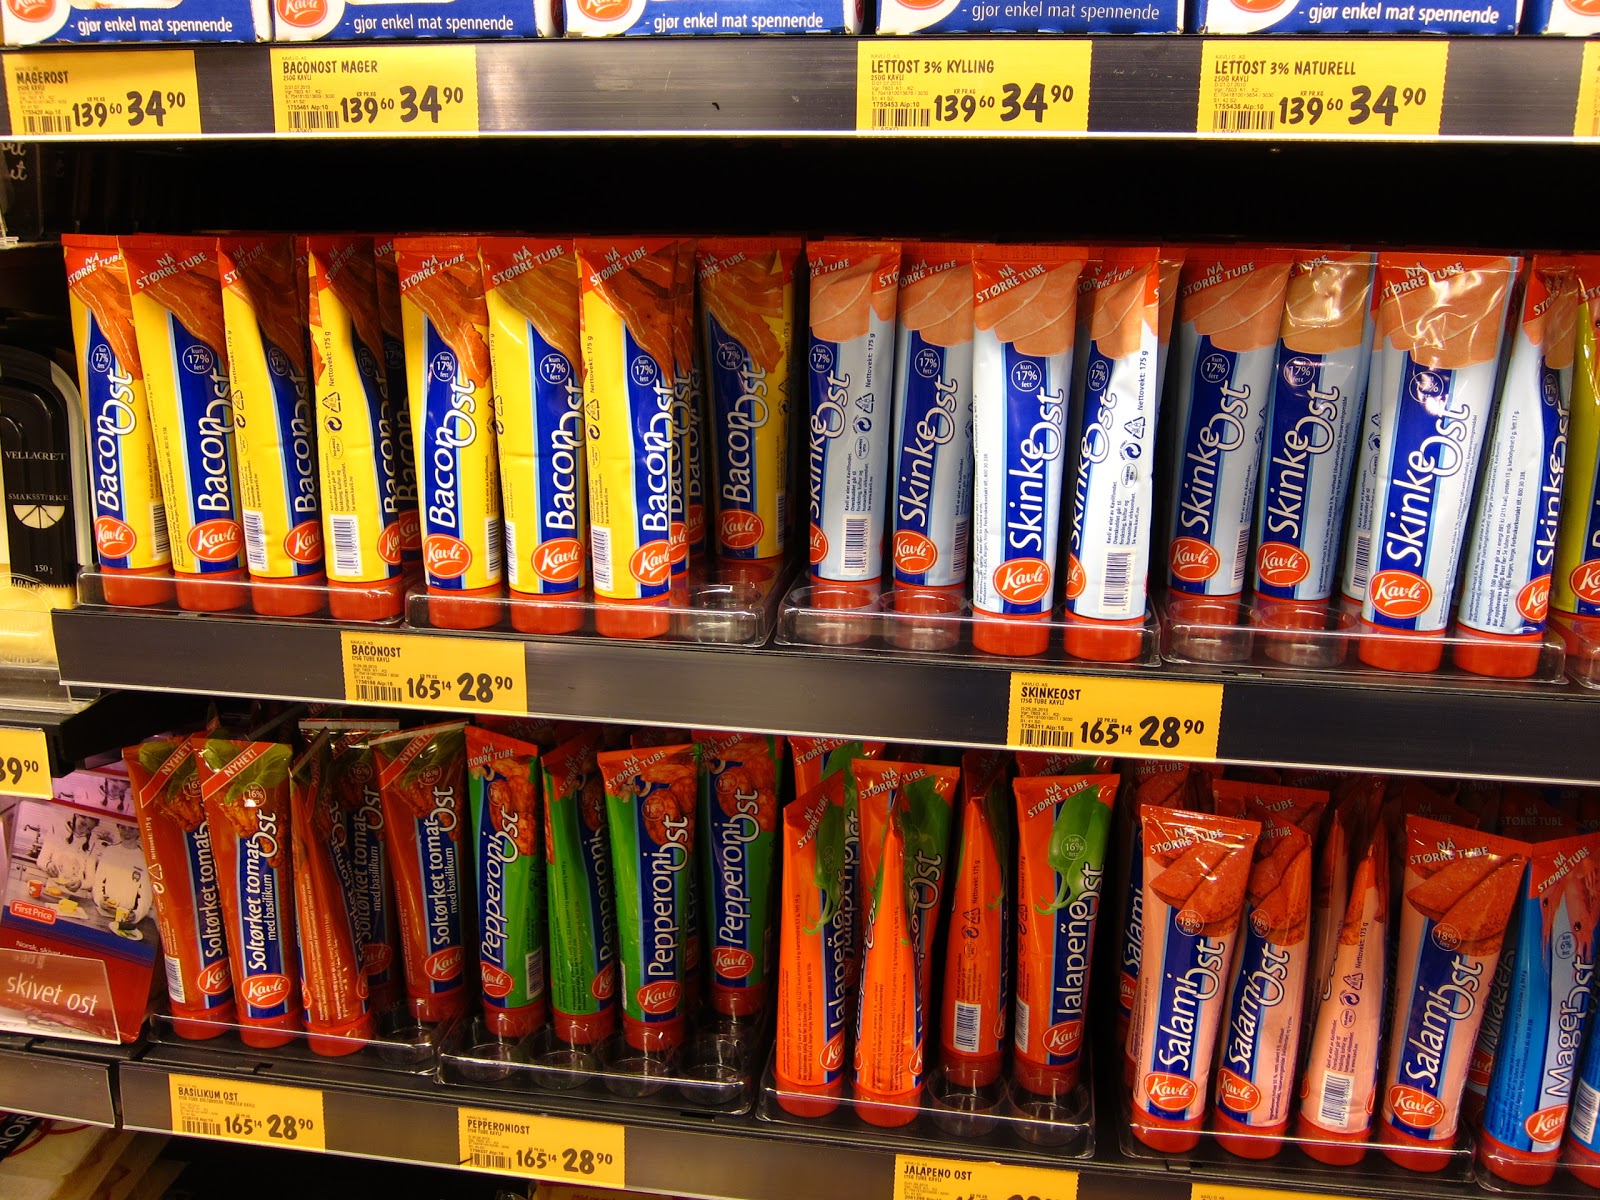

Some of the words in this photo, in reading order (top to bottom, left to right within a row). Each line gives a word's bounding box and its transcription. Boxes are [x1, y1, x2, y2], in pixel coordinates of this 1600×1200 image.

[653, 15, 679, 32] gjør
[683, 13, 717, 28] enkel
[722, 15, 747, 28] mat
[752, 12, 823, 32] spennende
[972, 4, 1000, 21] gjør
[1005, 1, 1042, 17] enkel
[1048, 4, 1075, 18] mat
[1080, 3, 1160, 22] spennende
[1309, 4, 1336, 23] gjør
[1341, 2, 1381, 19] enkel
[1385, 6, 1415, 20] mat
[1418, 6, 1499, 25] spennende
[77, 18, 101, 36] gjør
[105, 16, 137, 32] enkel
[140, 19, 164, 32] mat
[167, 16, 233, 35] spennende
[354, 17, 380, 34] gjør
[382, 14, 414, 29] enkel
[419, 16, 442, 29] mat
[446, 14, 513, 33] spennende
[16, 71, 69, 84] MAGEROST
[283, 61, 338, 74] BACONOST
[341, 60, 378, 73] MAGER
[872, 60, 920, 74] LETTOST
[924, 61, 942, 74] 3%
[947, 60, 994, 74] KYLLING
[1215, 61, 1266, 75] LETTOST
[1270, 62, 1289, 75] 3%
[1295, 61, 1356, 75] NATURELL
[127, 90, 166, 128] 34
[167, 92, 185, 109] 90
[340, 97, 378, 124] 139
[381, 98, 394, 110] 60
[400, 85, 442, 123] 34
[443, 87, 464, 104] 90
[934, 94, 976, 122] 139
[980, 96, 995, 108] 60
[1000, 83, 1048, 123] 34
[1051, 85, 1074, 103] 90
[1279, 96, 1323, 125] 139
[1327, 99, 1343, 110] 60
[1348, 85, 1399, 126] 34
[1403, 87, 1426, 106] 90
[72, 103, 107, 128] 139
[109, 104, 122, 114] 60
[157, 253, 175, 267] NÅ
[422, 254, 439, 269] NÅ
[492, 260, 535, 285] STØRRE
[534, 244, 564, 265] TUBE
[513, 246, 532, 262] NÅ
[136, 264, 179, 289] STØRRE
[180, 252, 208, 271] TUBE
[400, 267, 436, 291] STØRRE
[439, 253, 465, 270] TUBE
[998, 264, 1016, 278] NÅ
[976, 275, 1020, 303] STØRRE
[1019, 264, 1046, 281] TUBE
[436, 361, 453, 372] 17%
[545, 363, 565, 373] 17%
[635, 365, 653, 374] 17%
[1016, 370, 1037, 381] 17%
[1206, 362, 1225, 373] 17%
[5, 451, 67, 461] VELLACRET
[430, 376, 476, 528] BaconOst
[98, 523, 126, 543] Kavli
[198, 525, 237, 552] Kavli
[721, 517, 755, 541] Kavli
[427, 541, 462, 564] Kavli
[541, 543, 579, 571] Kavli
[896, 537, 927, 559] Kavli
[1173, 544, 1212, 565] Kavli
[639, 548, 670, 575] Kavli
[1261, 550, 1301, 571] Kavli
[1002, 567, 1044, 590] Kavli
[1374, 579, 1420, 602] Kavli
[351, 645, 401, 658] BACONOST
[407, 677, 441, 700] 165
[442, 681, 452, 691] 14
[457, 672, 494, 703] 28
[495, 676, 513, 691] 90
[1021, 687, 1081, 701] SKINKEOST
[1080, 721, 1119, 744] 165
[1121, 725, 1132, 735] 14
[1140, 716, 1181, 748] 28
[1184, 719, 1205, 735] 90
[24, 760, 38, 772] 90
[224, 749, 257, 777] NYHET!
[606, 765, 640, 789] STØRRE
[640, 750, 666, 768] TUBE
[623, 754, 639, 768] NÅ
[1028, 794, 1062, 818] STØRRE
[1063, 779, 1089, 797] TUBE
[1045, 782, 1061, 795] NÅ
[716, 953, 747, 970] Kavli
[7, 973, 63, 1006] skivet
[67, 989, 98, 1017] ost
[248, 981, 282, 1001] Kavli
[644, 984, 678, 1006] Kavli
[178, 1087, 220, 1099] BASILIKUM
[223, 1092, 238, 1101] OST
[1150, 1079, 1190, 1097] Kavli
[1221, 1075, 1251, 1100] Kavli
[1397, 1089, 1436, 1115] Kavli
[224, 1116, 253, 1135] 165
[254, 1120, 262, 1129] 14
[267, 1114, 297, 1140] 28
[299, 1118, 313, 1131] 90
[467, 1119, 531, 1135] PEPPERONIOST
[516, 1149, 547, 1170] 165
[548, 1154, 557, 1163] 14
[562, 1148, 595, 1175] 28
[596, 1152, 613, 1165] 90
[904, 1165, 951, 1179] JALAPENO
[954, 1170, 972, 1181] OST
